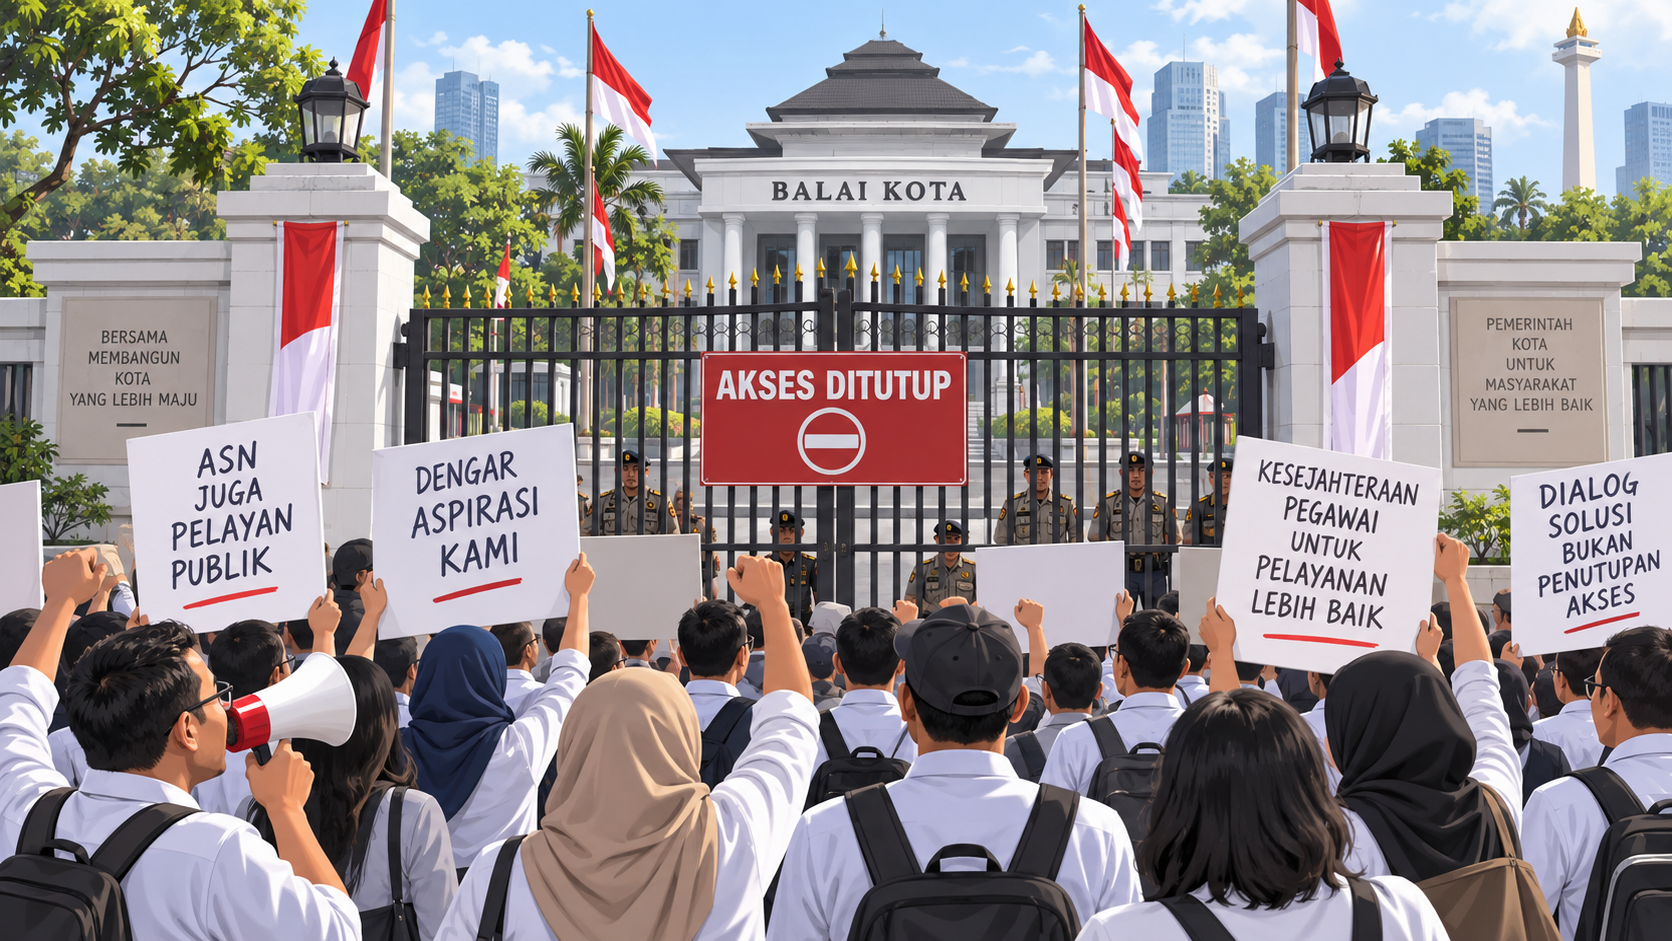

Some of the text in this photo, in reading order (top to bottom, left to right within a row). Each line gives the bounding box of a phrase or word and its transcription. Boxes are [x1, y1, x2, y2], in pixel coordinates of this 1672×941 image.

[771, 180, 967, 202] BALAI KOTA
[100, 329, 168, 345] BERSAMA
[1486, 316, 1573, 332] PEMERINTAH
[87, 350, 181, 366] MEMBANGUN
[1512, 337, 1548, 352] KOTA
[114, 370, 151, 386] KOTA
[1506, 357, 1556, 372] UNTUK
[69, 391, 198, 408] YANG LEBIH MAJU
[715, 369, 952, 402] AKSES DITUTUP
[1485, 377, 1578, 392] MASYARAKAT
[1469, 397, 1594, 412] YANG LEBIH BAIK
[196, 440, 257, 479] ASN
[415, 450, 518, 496] DENGAR
[194, 476, 263, 512] JUGA
[1257, 458, 1420, 507] KESEJAHTERAAN
[1538, 471, 1639, 510] DIALOG
[171, 502, 293, 552] PELAYAN
[410, 485, 539, 540] ASPIRASI
[1283, 495, 1379, 534] PEGAWAI
[1548, 501, 1632, 539] SOLUSI
[440, 531, 518, 578] KAMI
[1290, 530, 1363, 562] UNTUK
[1562, 529, 1633, 565] BUKAN
[171, 545, 273, 591] PUBLIK
[1255, 554, 1388, 597] PELAYANAN
[1537, 549, 1660, 598] PENUTUPAN
[1251, 588, 1385, 630] LEBIH BAIK
[1566, 582, 1636, 619] AKSES
